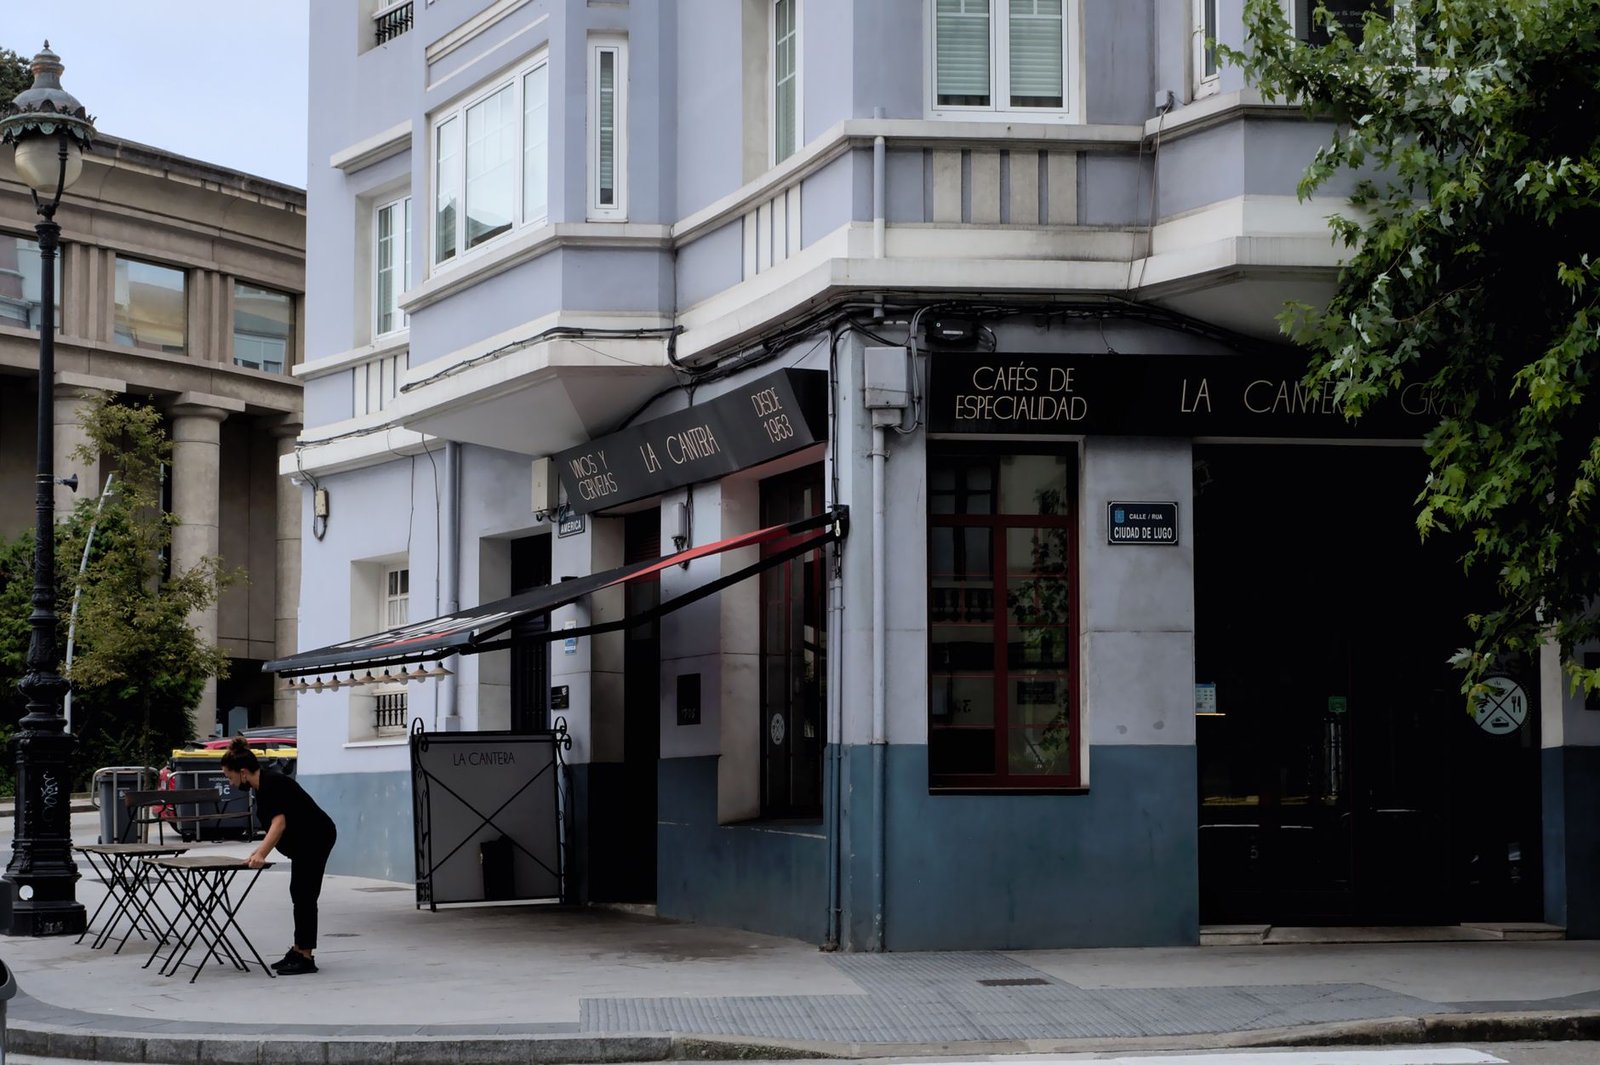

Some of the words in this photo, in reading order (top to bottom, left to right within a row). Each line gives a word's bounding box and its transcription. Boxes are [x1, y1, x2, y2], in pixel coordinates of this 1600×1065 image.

[973, 361, 1038, 391] CAFÉS
[1049, 368, 1075, 392] DE
[751, 387, 783, 417] DESDE
[955, 395, 1087, 420] ESPECIALIDAD
[1181, 378, 1211, 413] LA
[763, 414, 794, 443] 1953
[597, 450, 608, 469] Y
[639, 442, 662, 473] LA
[666, 424, 720, 464] CANTERA
[578, 472, 618, 501] CERVEZAS
[1114, 527, 1140, 539] CIUDAD
[1142, 527, 1152, 539] DE
[1153, 527, 1173, 539] LUGO
[452, 752, 467, 766] LA
[468, 751, 515, 766] CANTERA
